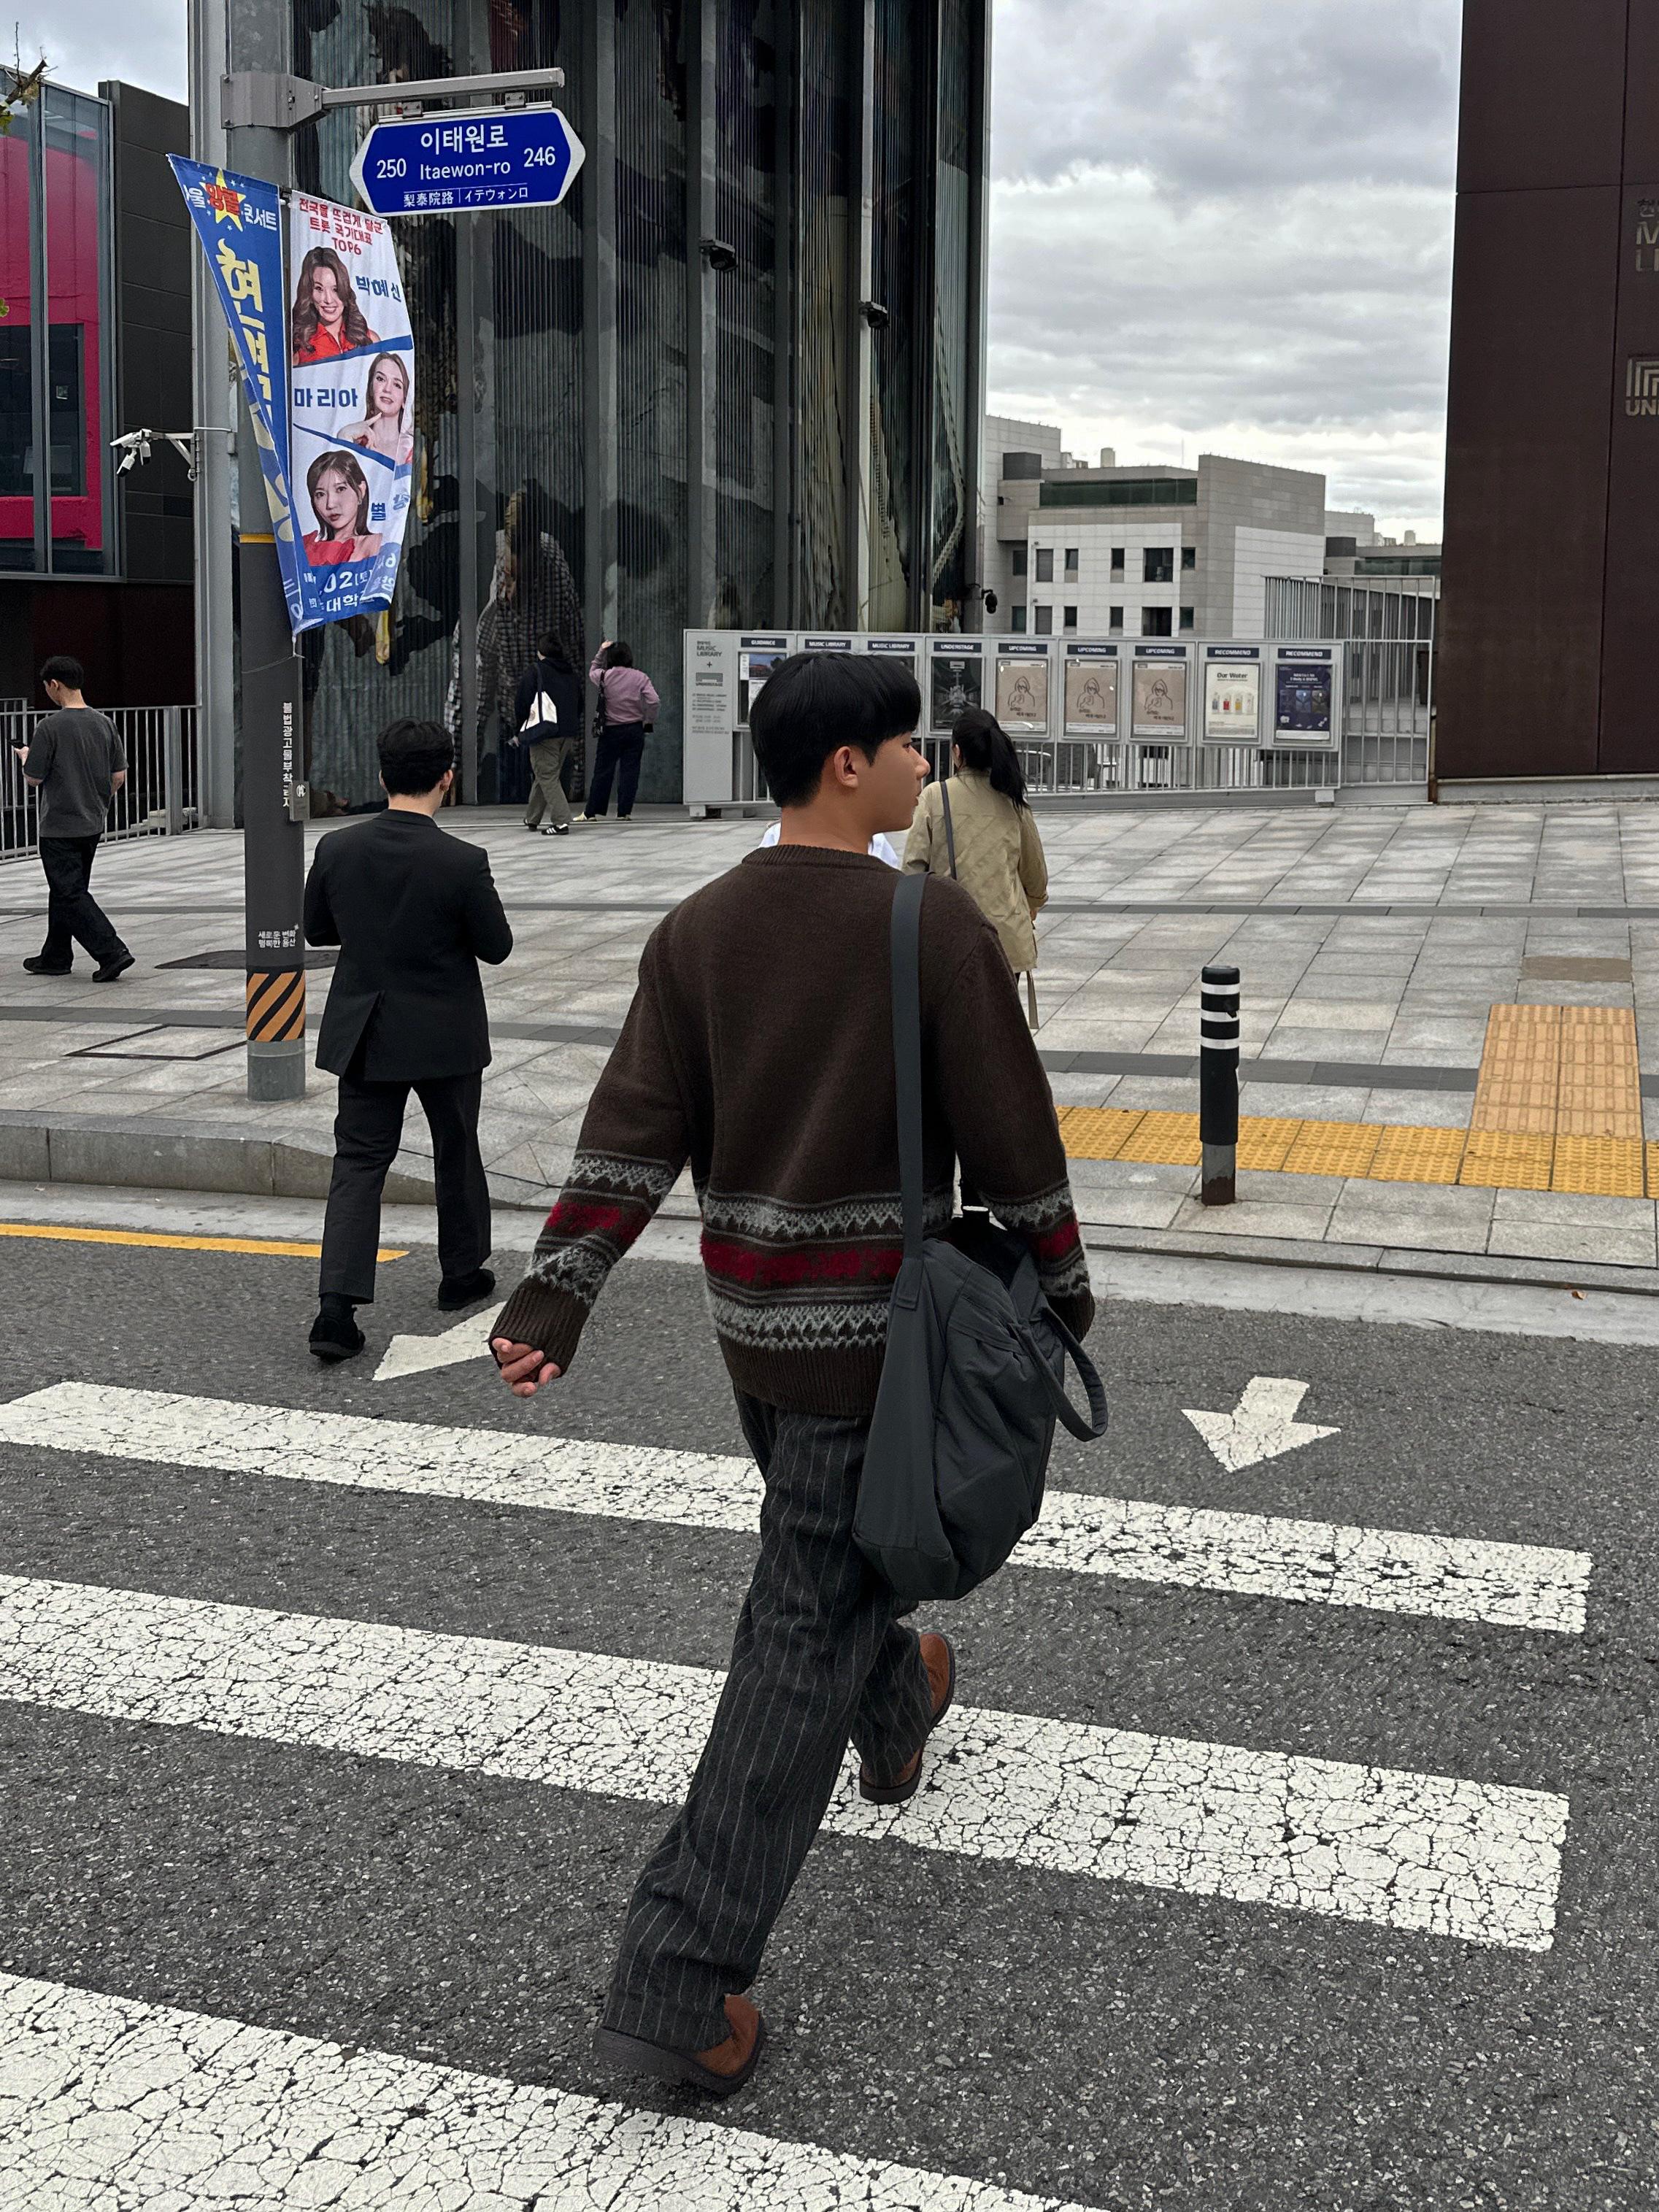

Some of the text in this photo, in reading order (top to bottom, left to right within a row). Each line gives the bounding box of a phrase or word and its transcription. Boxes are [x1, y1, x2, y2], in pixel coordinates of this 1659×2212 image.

[420, 124, 509, 155] 이태원로
[523, 147, 555, 167] 246
[377, 158, 407, 179] 250
[420, 161, 511, 180] Itaewon-ro
[404, 191, 454, 207] 梨泰院路
[465, 187, 528, 203] イテウォンロ
[244, 203, 277, 231] 콘서트
[299, 198, 328, 218] 전국을
[332, 208, 362, 228] 뜨겁게
[331, 237, 361, 255] TOP6
[355, 276, 401, 303] 박혜신
[294, 388, 358, 408] 마리아
[1625, 399, 1659, 416] UN
[258, 930, 281, 939] 새로운
[282, 938, 296, 948] 용산
